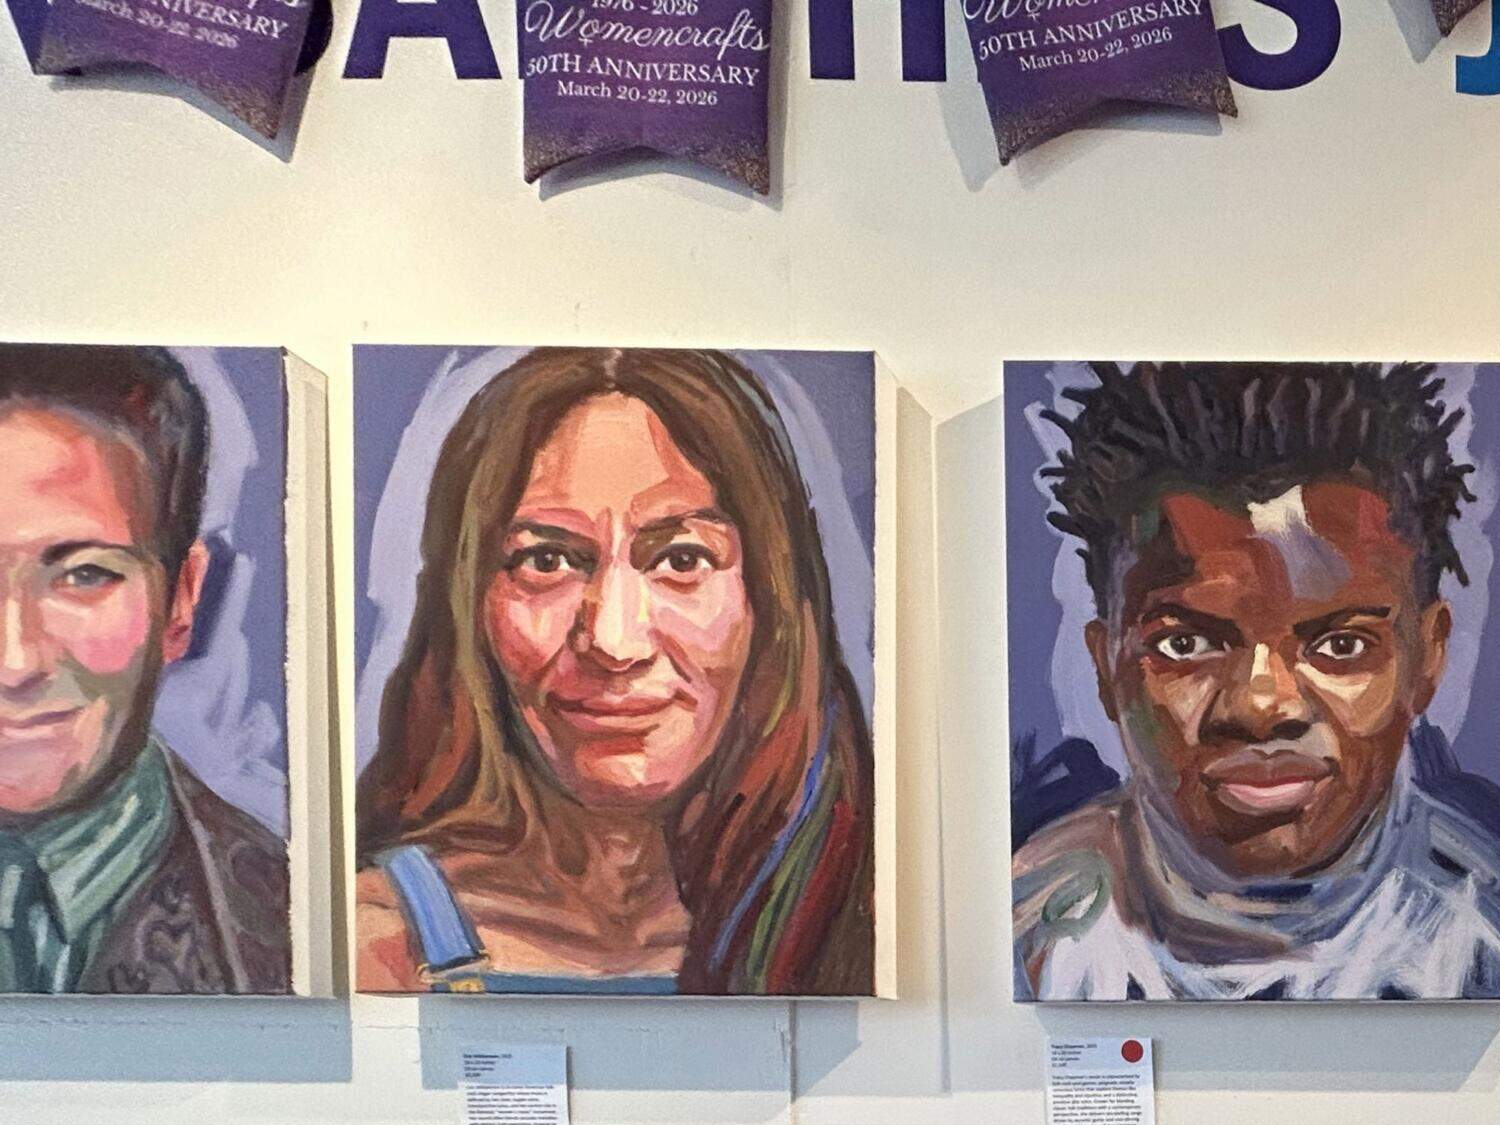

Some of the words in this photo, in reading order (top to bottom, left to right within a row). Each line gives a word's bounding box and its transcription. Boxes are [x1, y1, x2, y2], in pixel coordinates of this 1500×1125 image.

[524, 0, 771, 60] Womencrafts
[979, 30, 1036, 60] 50TH
[1043, 0, 1204, 45] ANNIVERSARY
[1019, 47, 1074, 72] March
[1079, 41, 1130, 64] 20-22,
[1131, 27, 1173, 49] 2026
[557, 81, 612, 98] March
[617, 85, 672, 105] 20-22,
[676, 90, 718, 106] 2026
[587, 56, 760, 87] ANNIVERSARY
